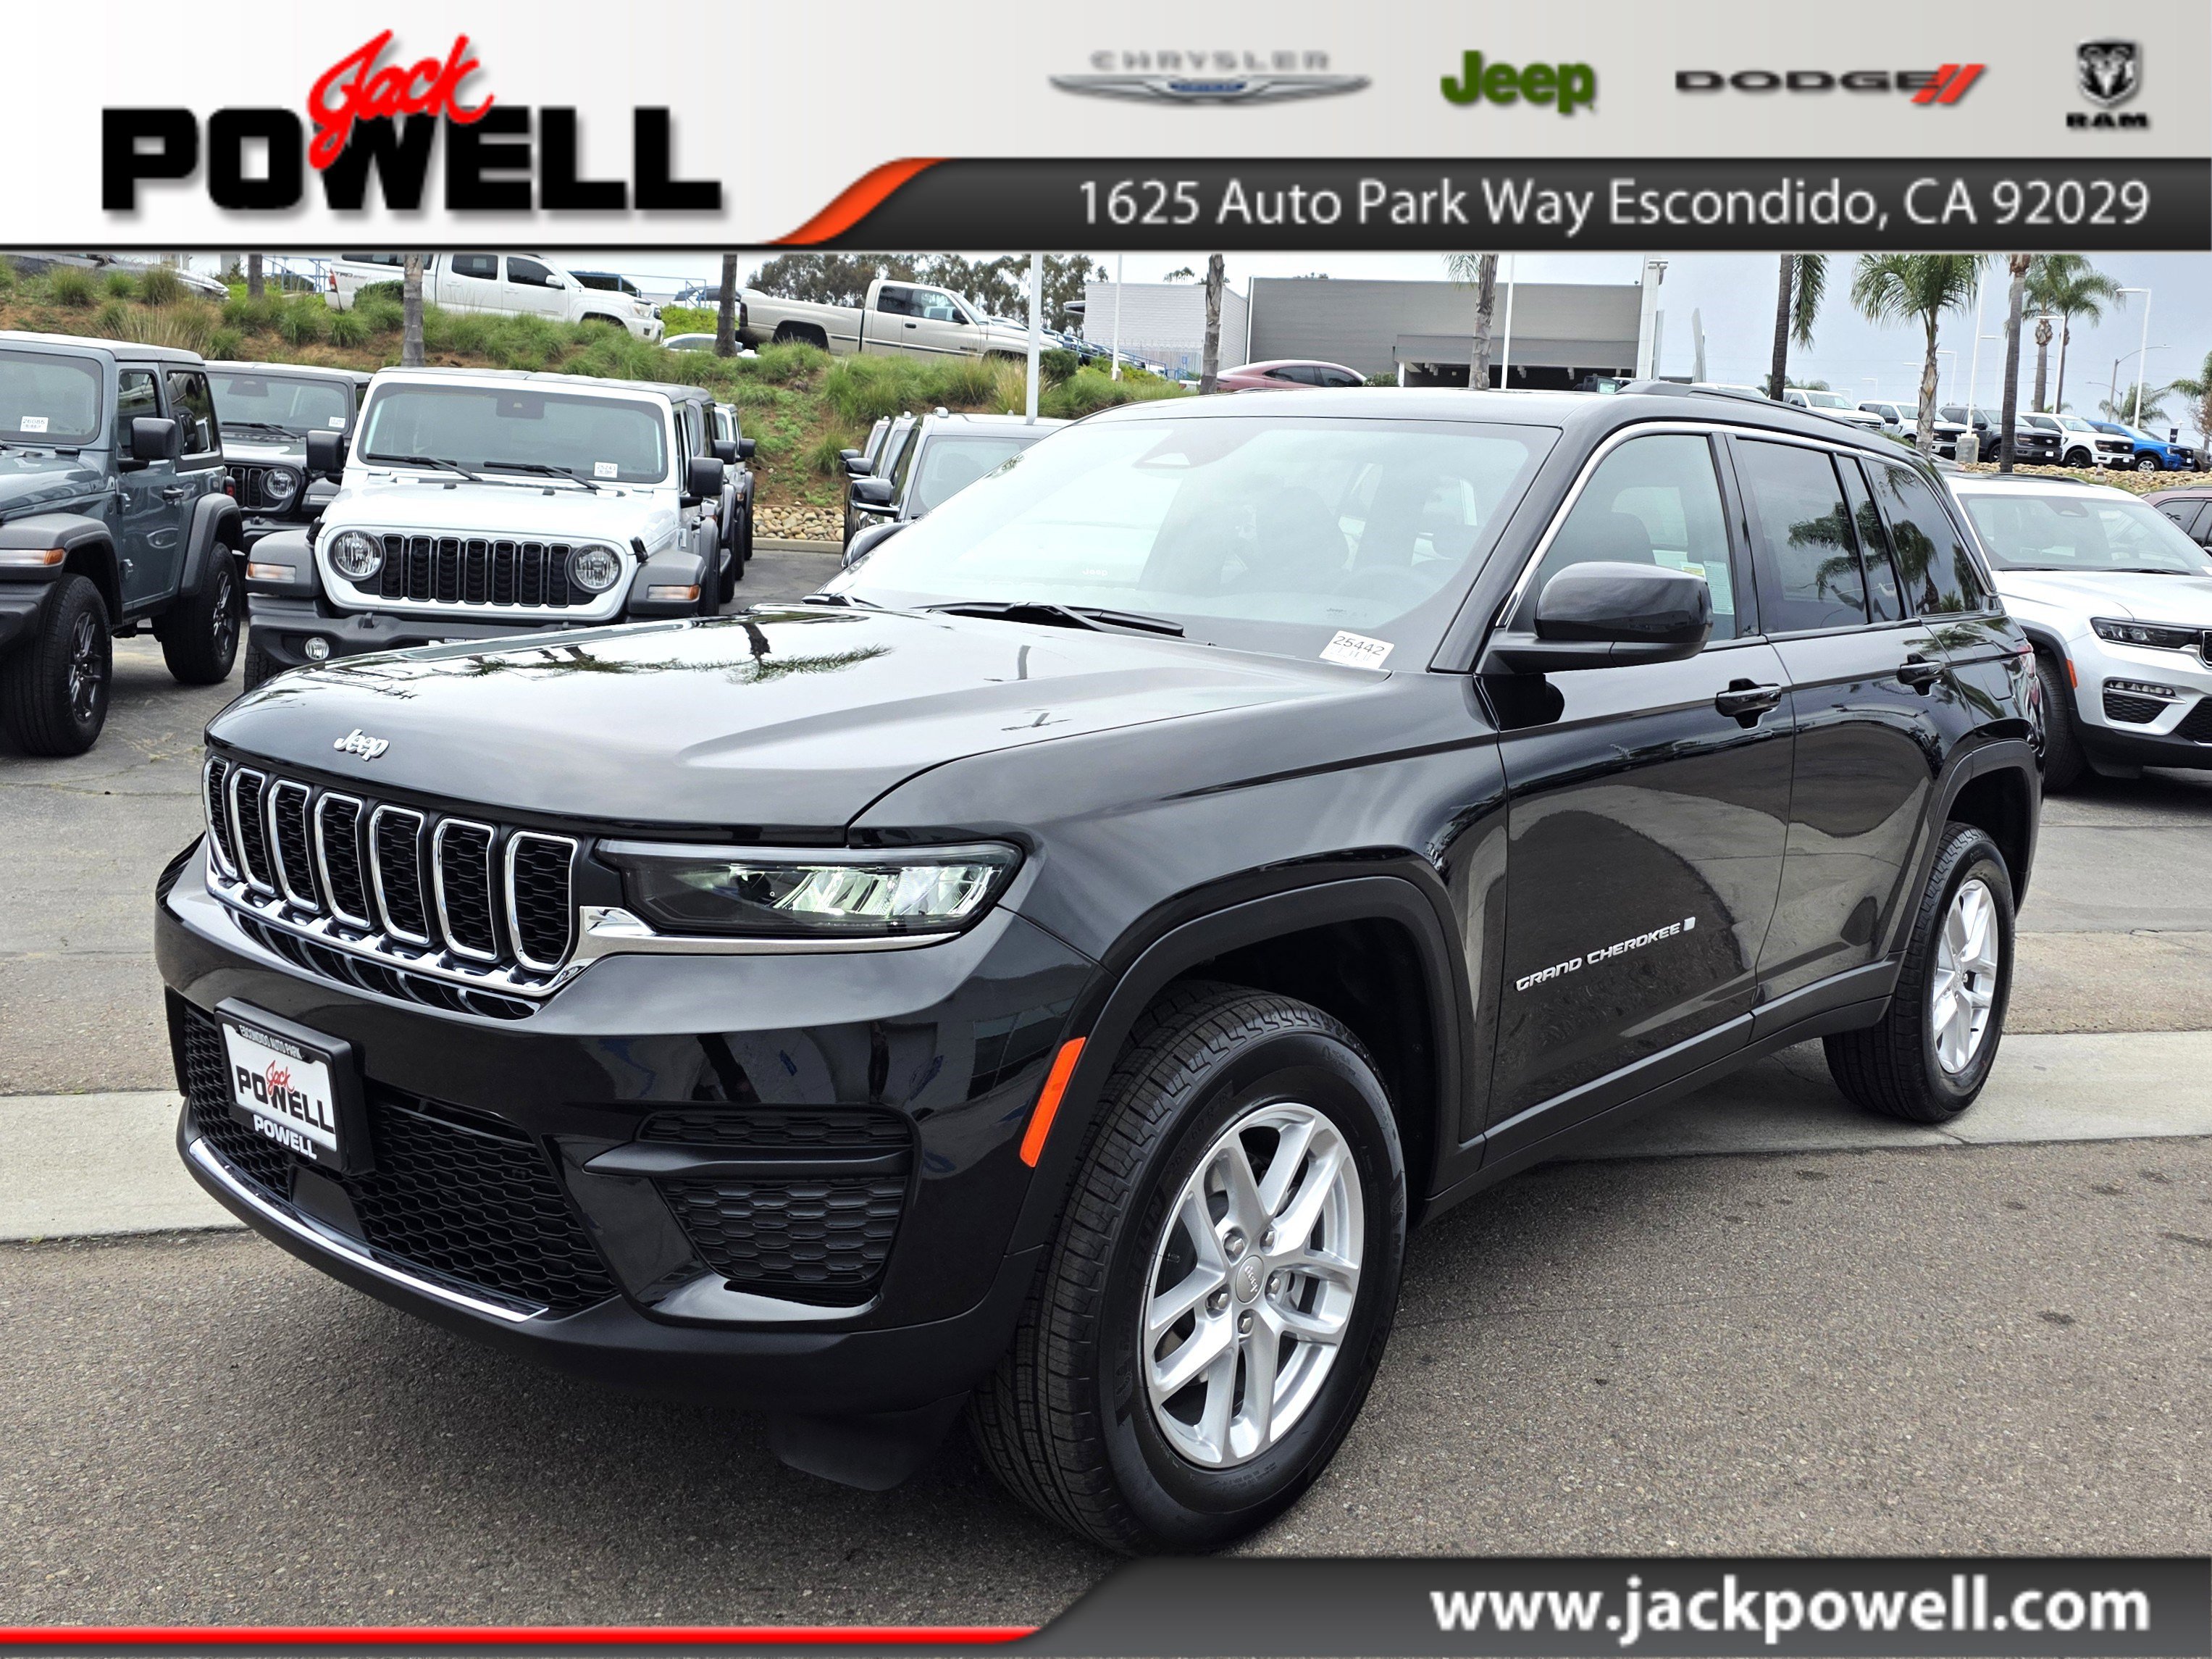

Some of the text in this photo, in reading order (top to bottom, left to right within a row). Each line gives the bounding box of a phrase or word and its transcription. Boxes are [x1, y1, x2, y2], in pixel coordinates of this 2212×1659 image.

[1333, 635, 1385, 656] 25442
[333, 728, 390, 761] Jeep
[1515, 922, 1680, 992] GRAND CHEROKEE
[235, 1064, 336, 1134] POWELL
[265, 1060, 295, 1097] Jack
[253, 1115, 317, 1160] POWELL
